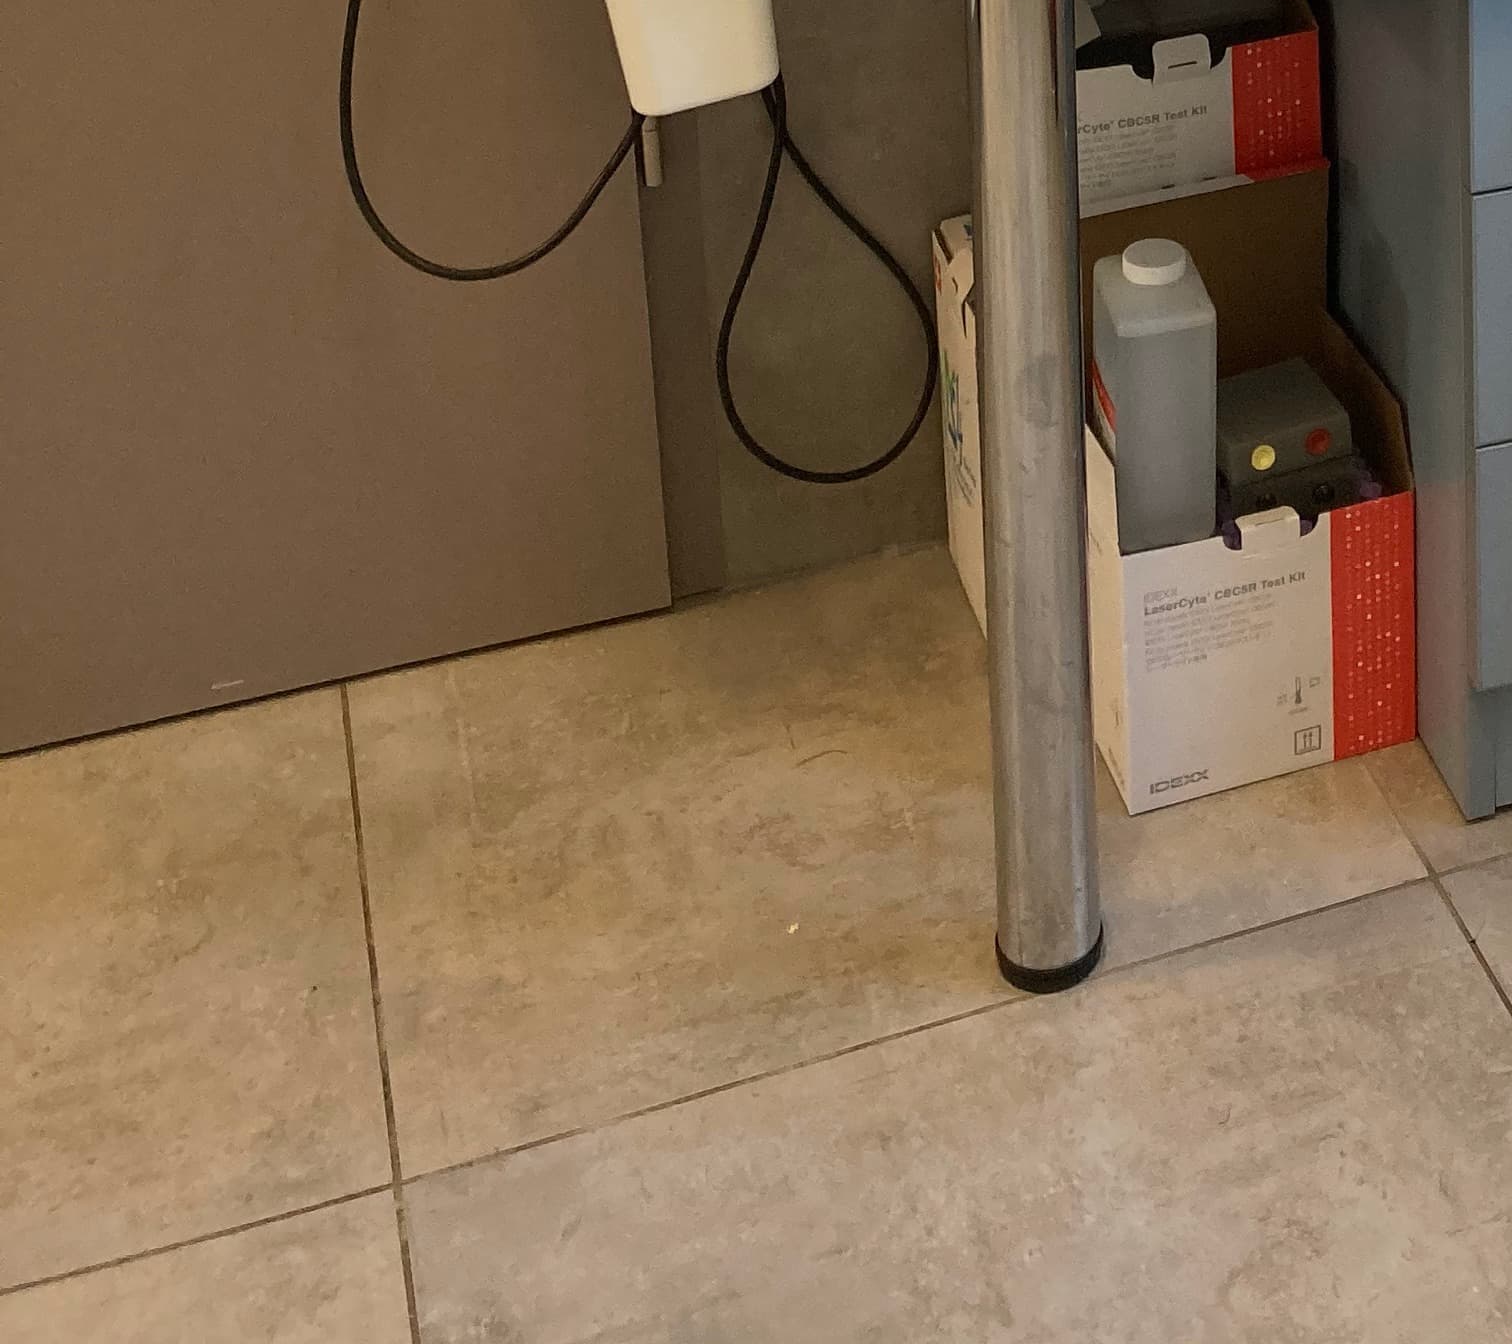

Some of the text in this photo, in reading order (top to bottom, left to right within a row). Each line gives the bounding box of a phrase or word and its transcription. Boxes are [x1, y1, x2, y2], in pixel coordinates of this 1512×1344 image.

[1164, 109, 1189, 122] Test
[1191, 104, 1208, 116] Kit
[1261, 576, 1286, 590] Test
[1289, 570, 1306, 584] Kit
[1149, 768, 1210, 795] IDEXX
